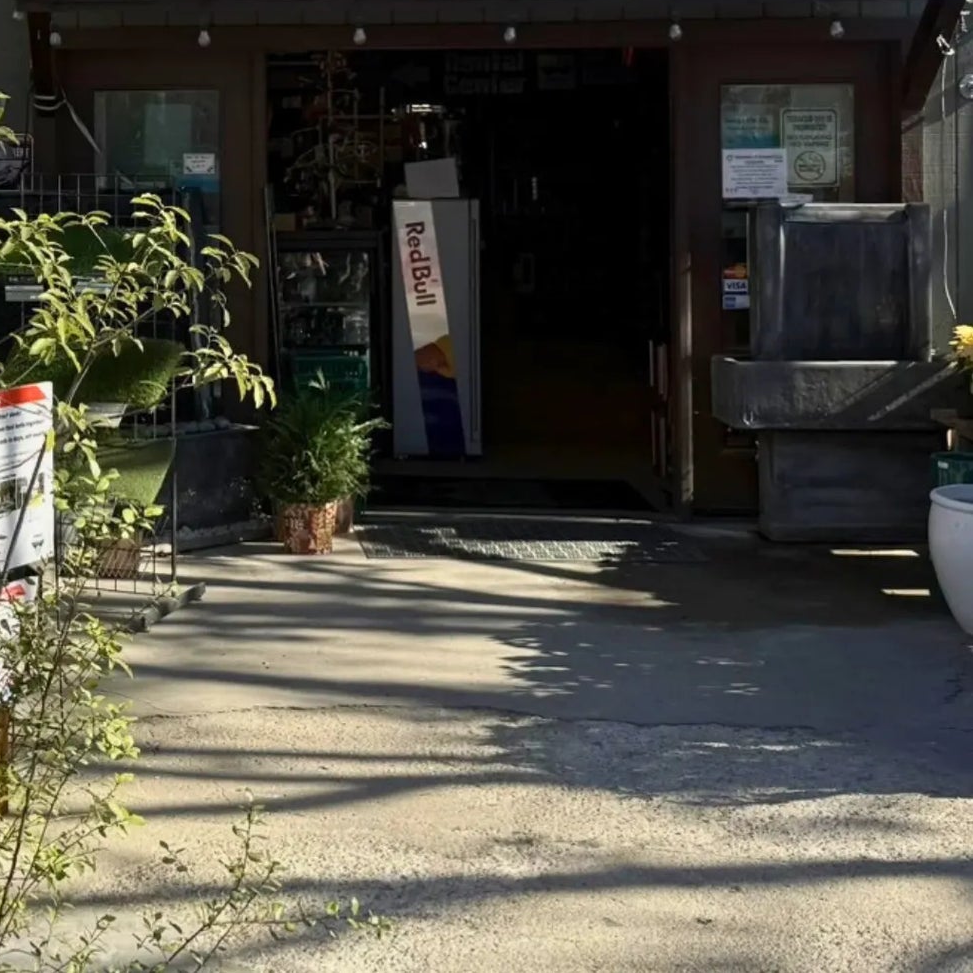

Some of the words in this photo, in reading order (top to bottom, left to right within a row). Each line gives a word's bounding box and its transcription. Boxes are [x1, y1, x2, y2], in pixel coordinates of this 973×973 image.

[405, 221, 431, 264] Red
[411, 265, 437, 306] Bull
[726, 282, 746, 290] VISA
